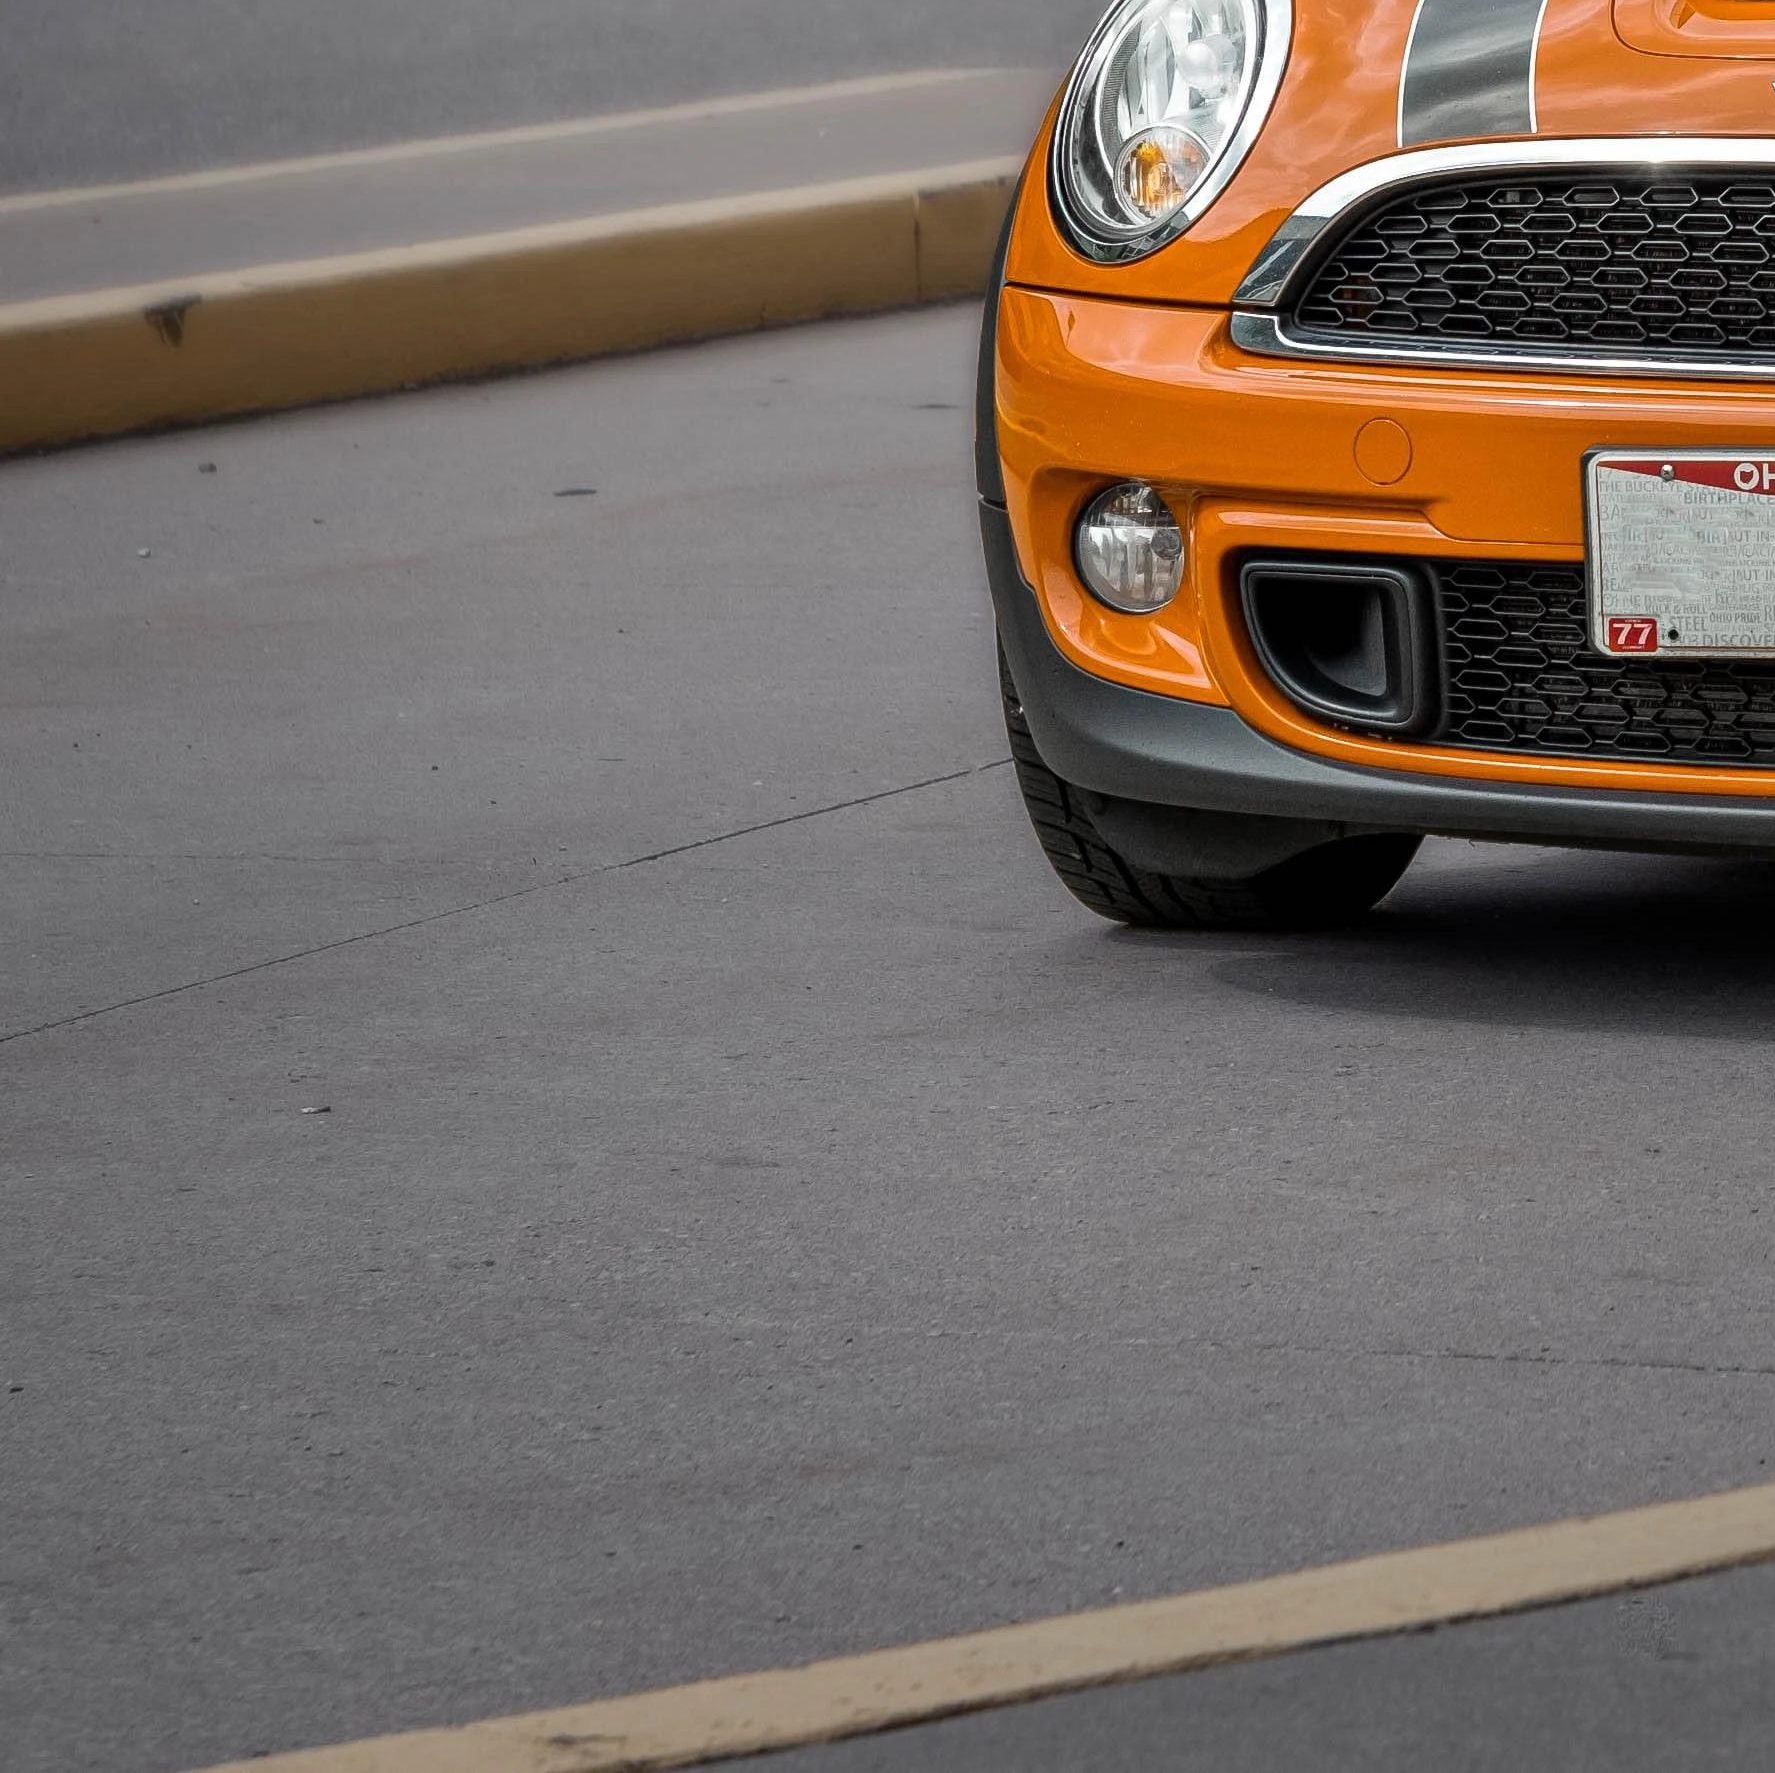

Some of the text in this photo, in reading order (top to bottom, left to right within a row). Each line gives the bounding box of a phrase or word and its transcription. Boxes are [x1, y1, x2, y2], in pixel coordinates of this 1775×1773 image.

[1684, 491, 1775, 505] BIRTHPLACE
[1669, 616, 1708, 631] STEEL
[1613, 623, 1653, 645] 77
